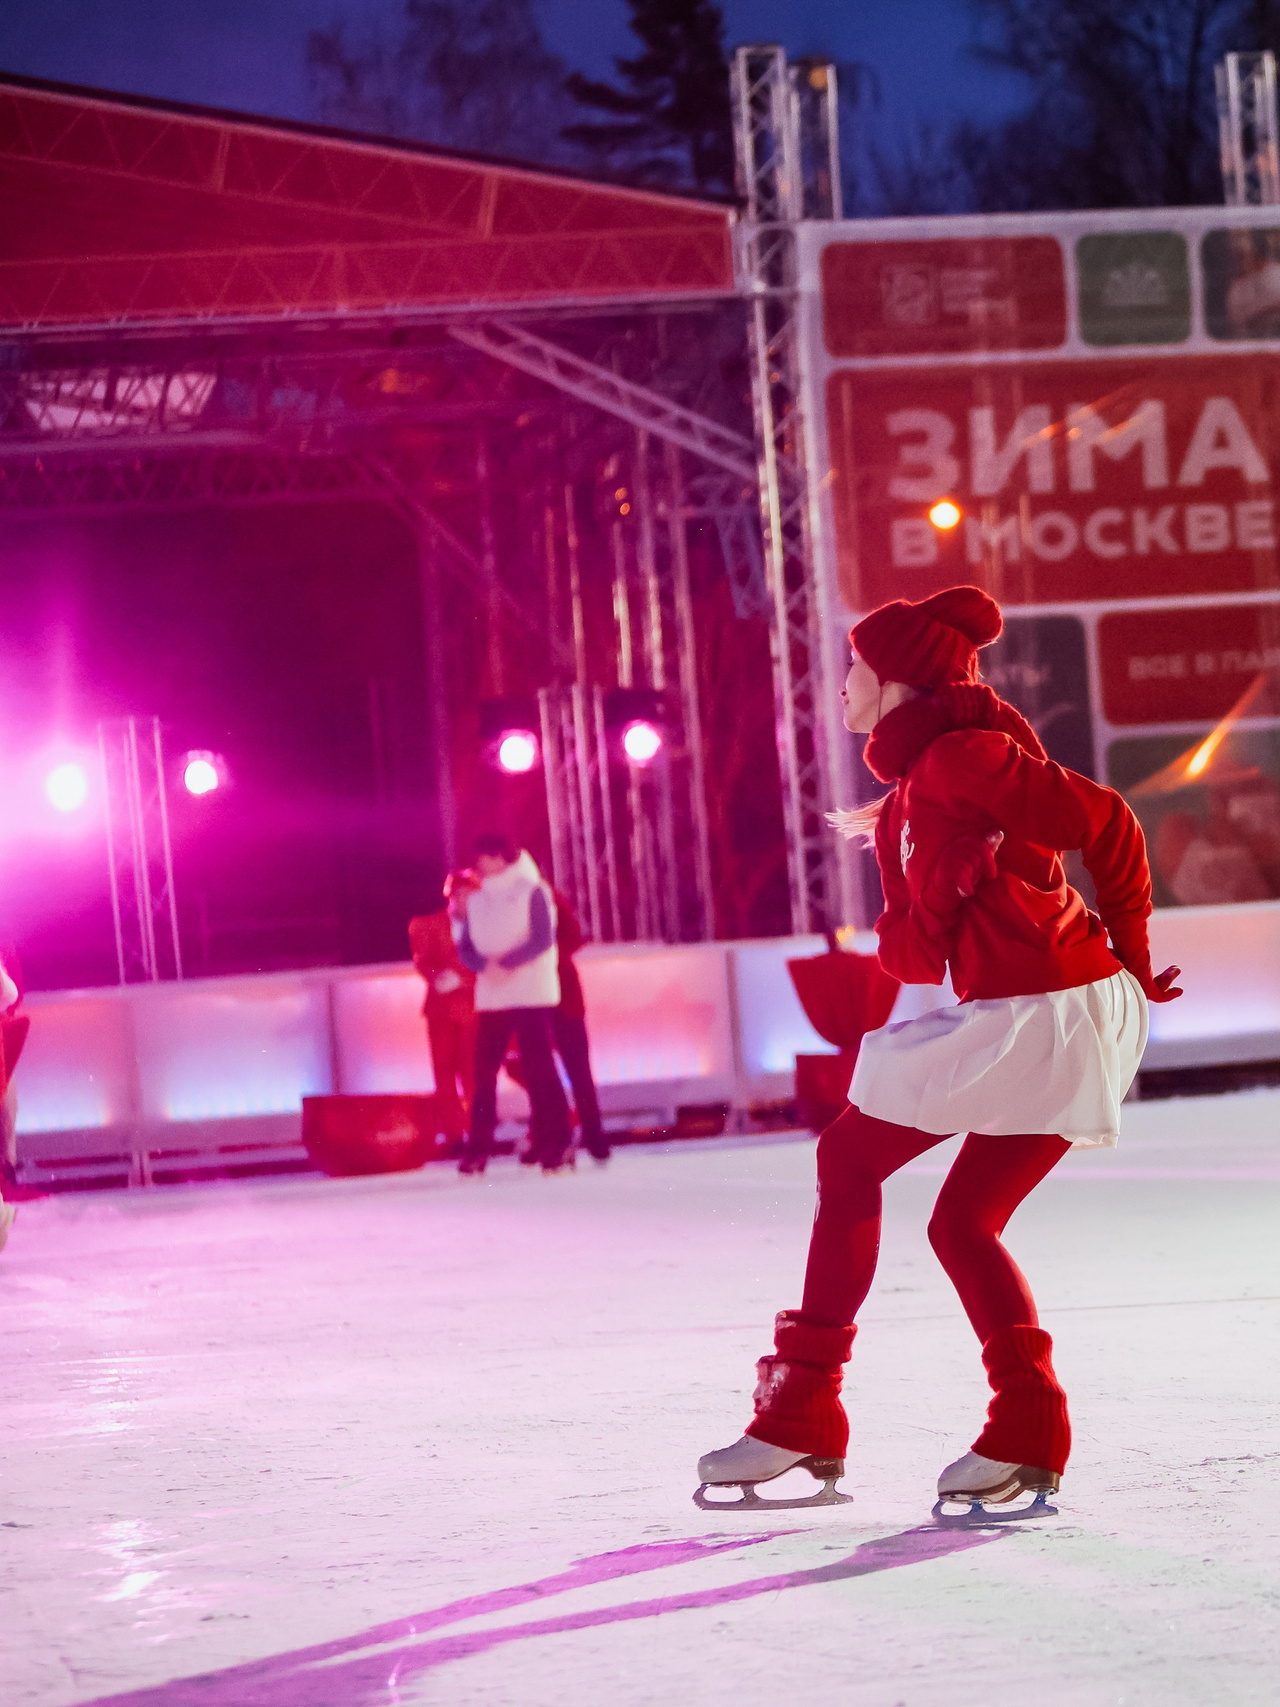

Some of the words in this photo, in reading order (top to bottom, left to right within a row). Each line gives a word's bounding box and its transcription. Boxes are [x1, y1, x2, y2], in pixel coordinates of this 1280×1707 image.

[886, 397, 1271, 502] ЗИМА
[892, 516, 938, 568] В
[965, 501, 1276, 565] МОСКВЕ
